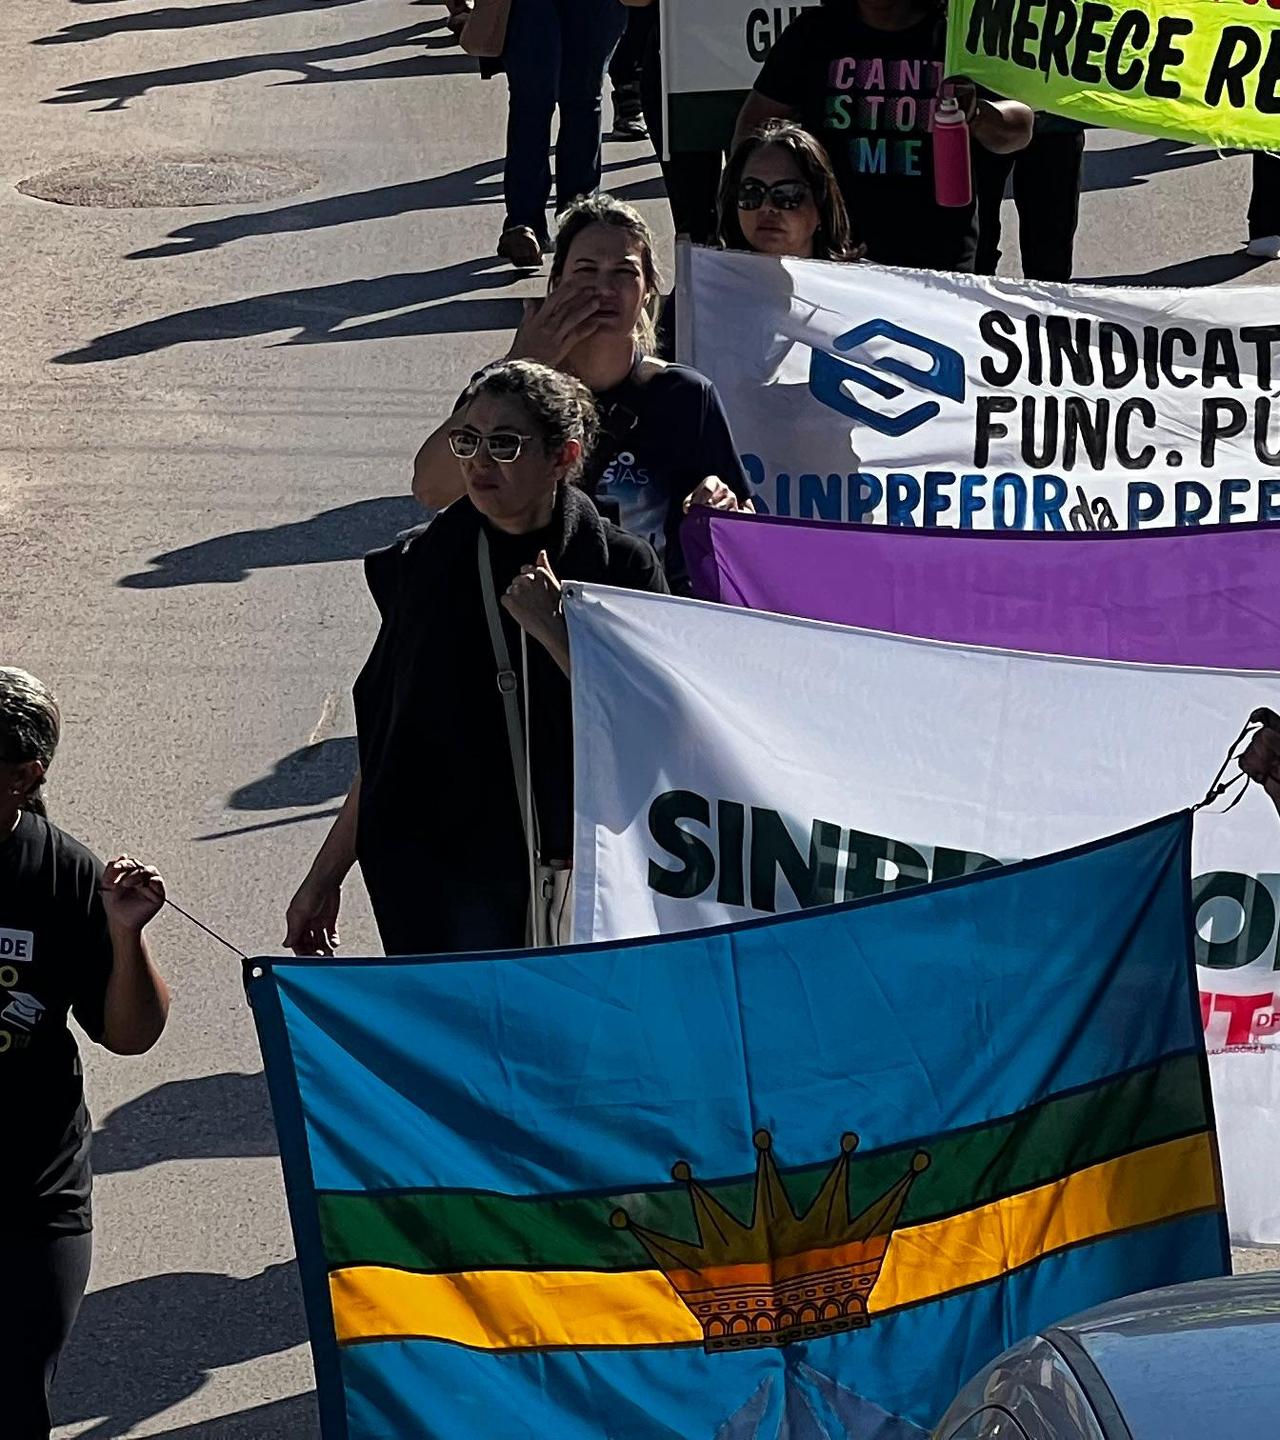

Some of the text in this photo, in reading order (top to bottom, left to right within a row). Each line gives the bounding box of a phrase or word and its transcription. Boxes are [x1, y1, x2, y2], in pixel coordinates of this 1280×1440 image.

[859, 137, 922, 176] ME
[973, 396, 1181, 471] FUNC.
[1069, 486, 1118, 532] da
[0, 938, 27, 957] DE
[1256, 1013, 1280, 1027] DF
